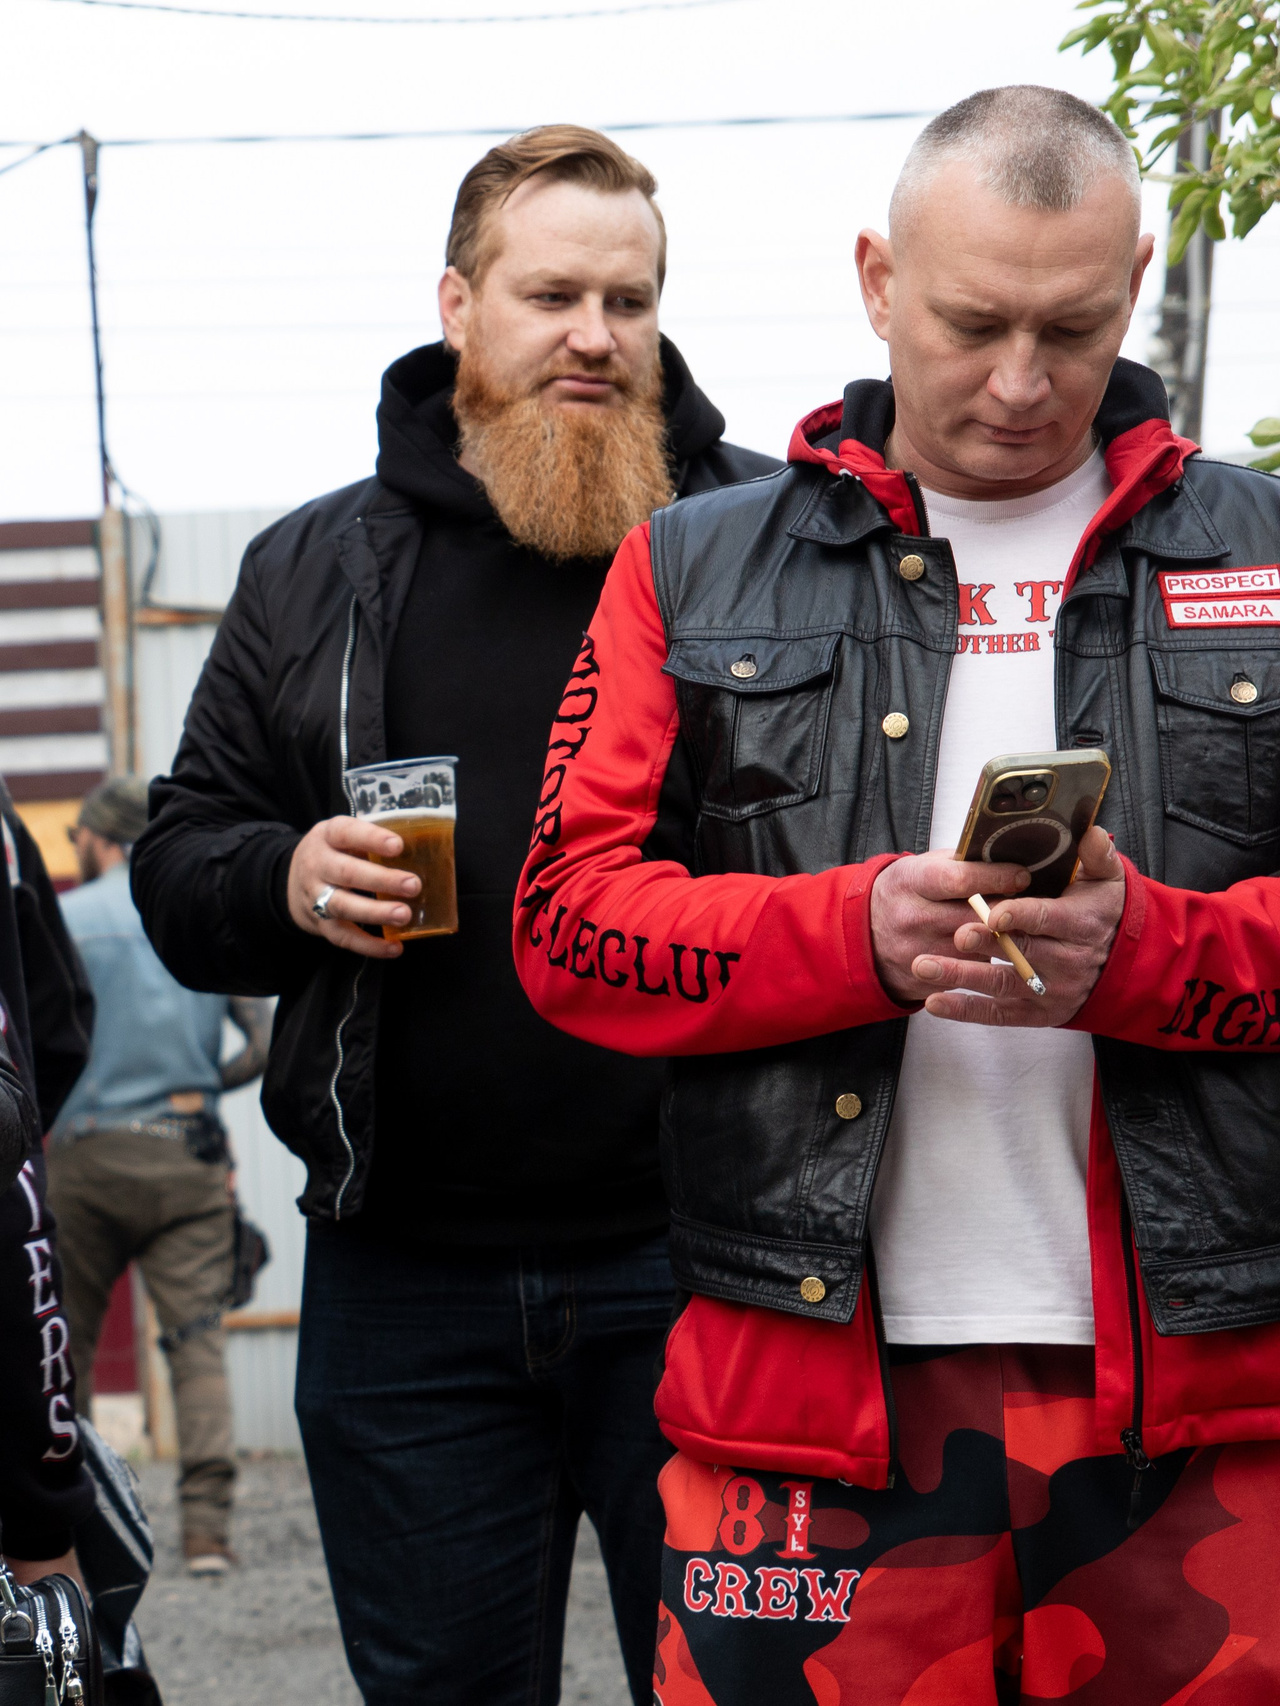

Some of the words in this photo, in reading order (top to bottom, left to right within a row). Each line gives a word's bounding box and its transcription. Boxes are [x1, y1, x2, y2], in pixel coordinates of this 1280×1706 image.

[1167, 573, 1276, 591] PROSPECT
[1183, 604, 1274, 619] SAMARA
[718, 1476, 818, 1559] 81
[683, 1557, 861, 1623] CREW
